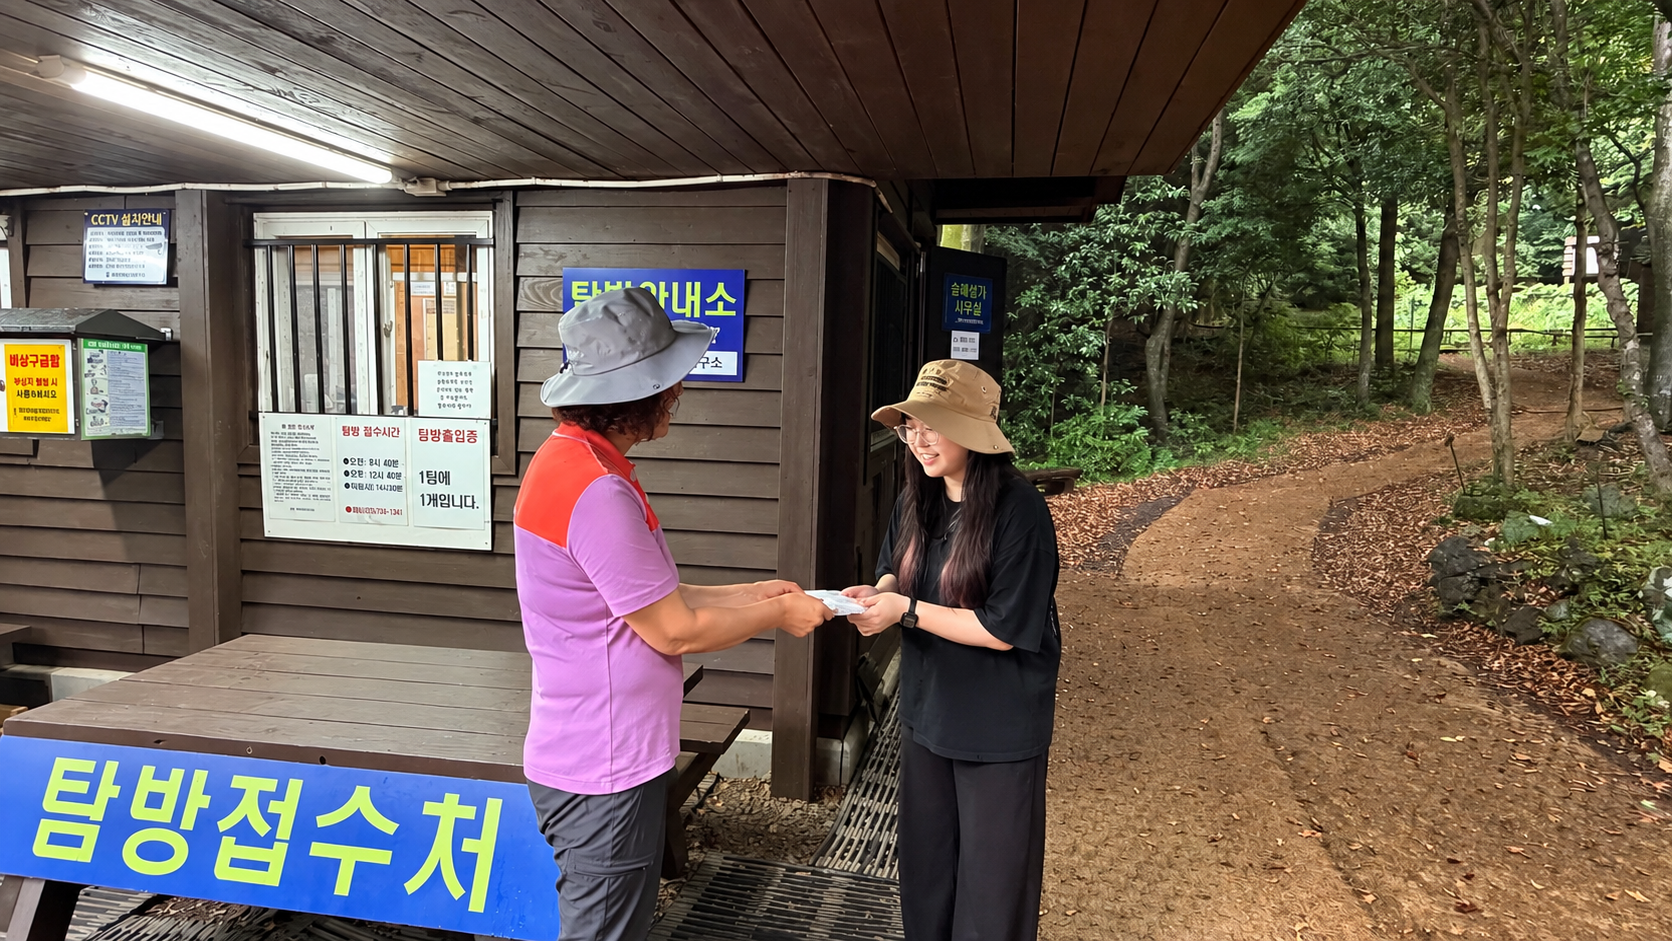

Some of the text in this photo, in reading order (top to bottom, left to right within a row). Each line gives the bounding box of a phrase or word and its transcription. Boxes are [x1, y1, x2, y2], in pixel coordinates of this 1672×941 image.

[91, 212, 162, 226] CCTV 설치안내
[9, 354, 60, 368] 비상구급함
[363, 426, 400, 438] 접수시간
[420, 493, 479, 509] 1개입니다.
[32, 756, 504, 914] 탐방접수처
